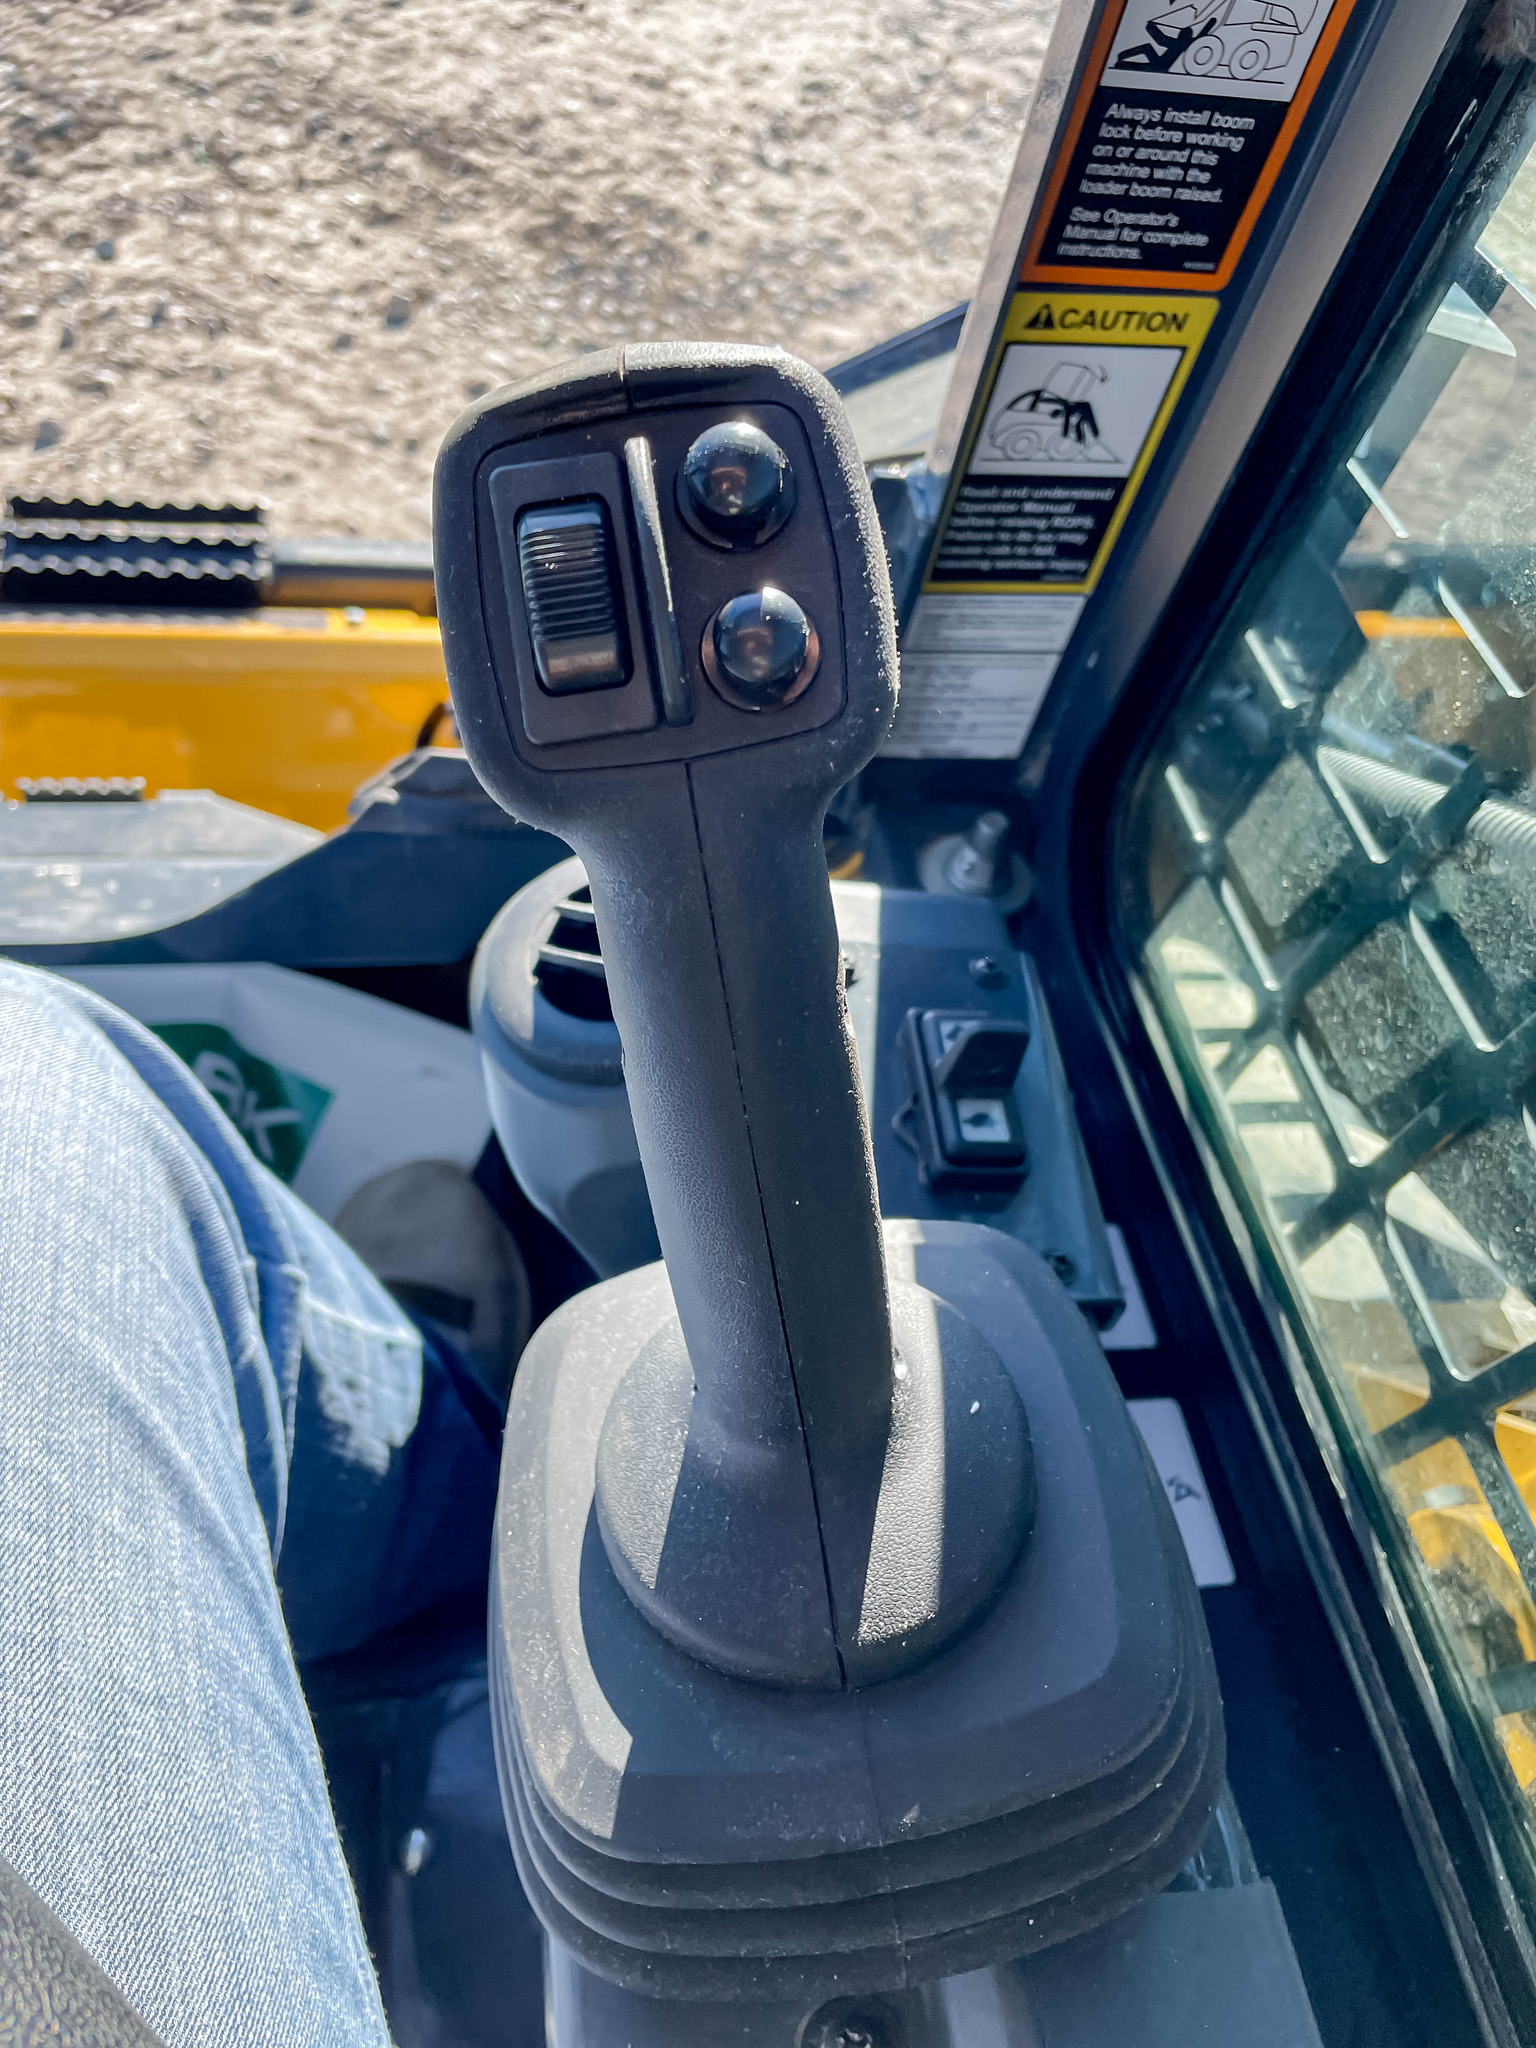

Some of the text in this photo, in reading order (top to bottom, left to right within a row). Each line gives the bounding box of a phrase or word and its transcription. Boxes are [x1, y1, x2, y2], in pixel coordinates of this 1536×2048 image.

[1105, 103, 1255, 130] Always install boom
[1099, 122, 1245, 152] lock before working
[1092, 144, 1220, 166] on or around this
[1085, 162, 1212, 184] machine with the
[1079, 179, 1129, 196] loader
[1129, 181, 1172, 199] boom
[1069, 206, 1101, 223] See
[1062, 224, 1209, 248] Manual for complete
[1059, 308, 1190, 333] CAUTION
